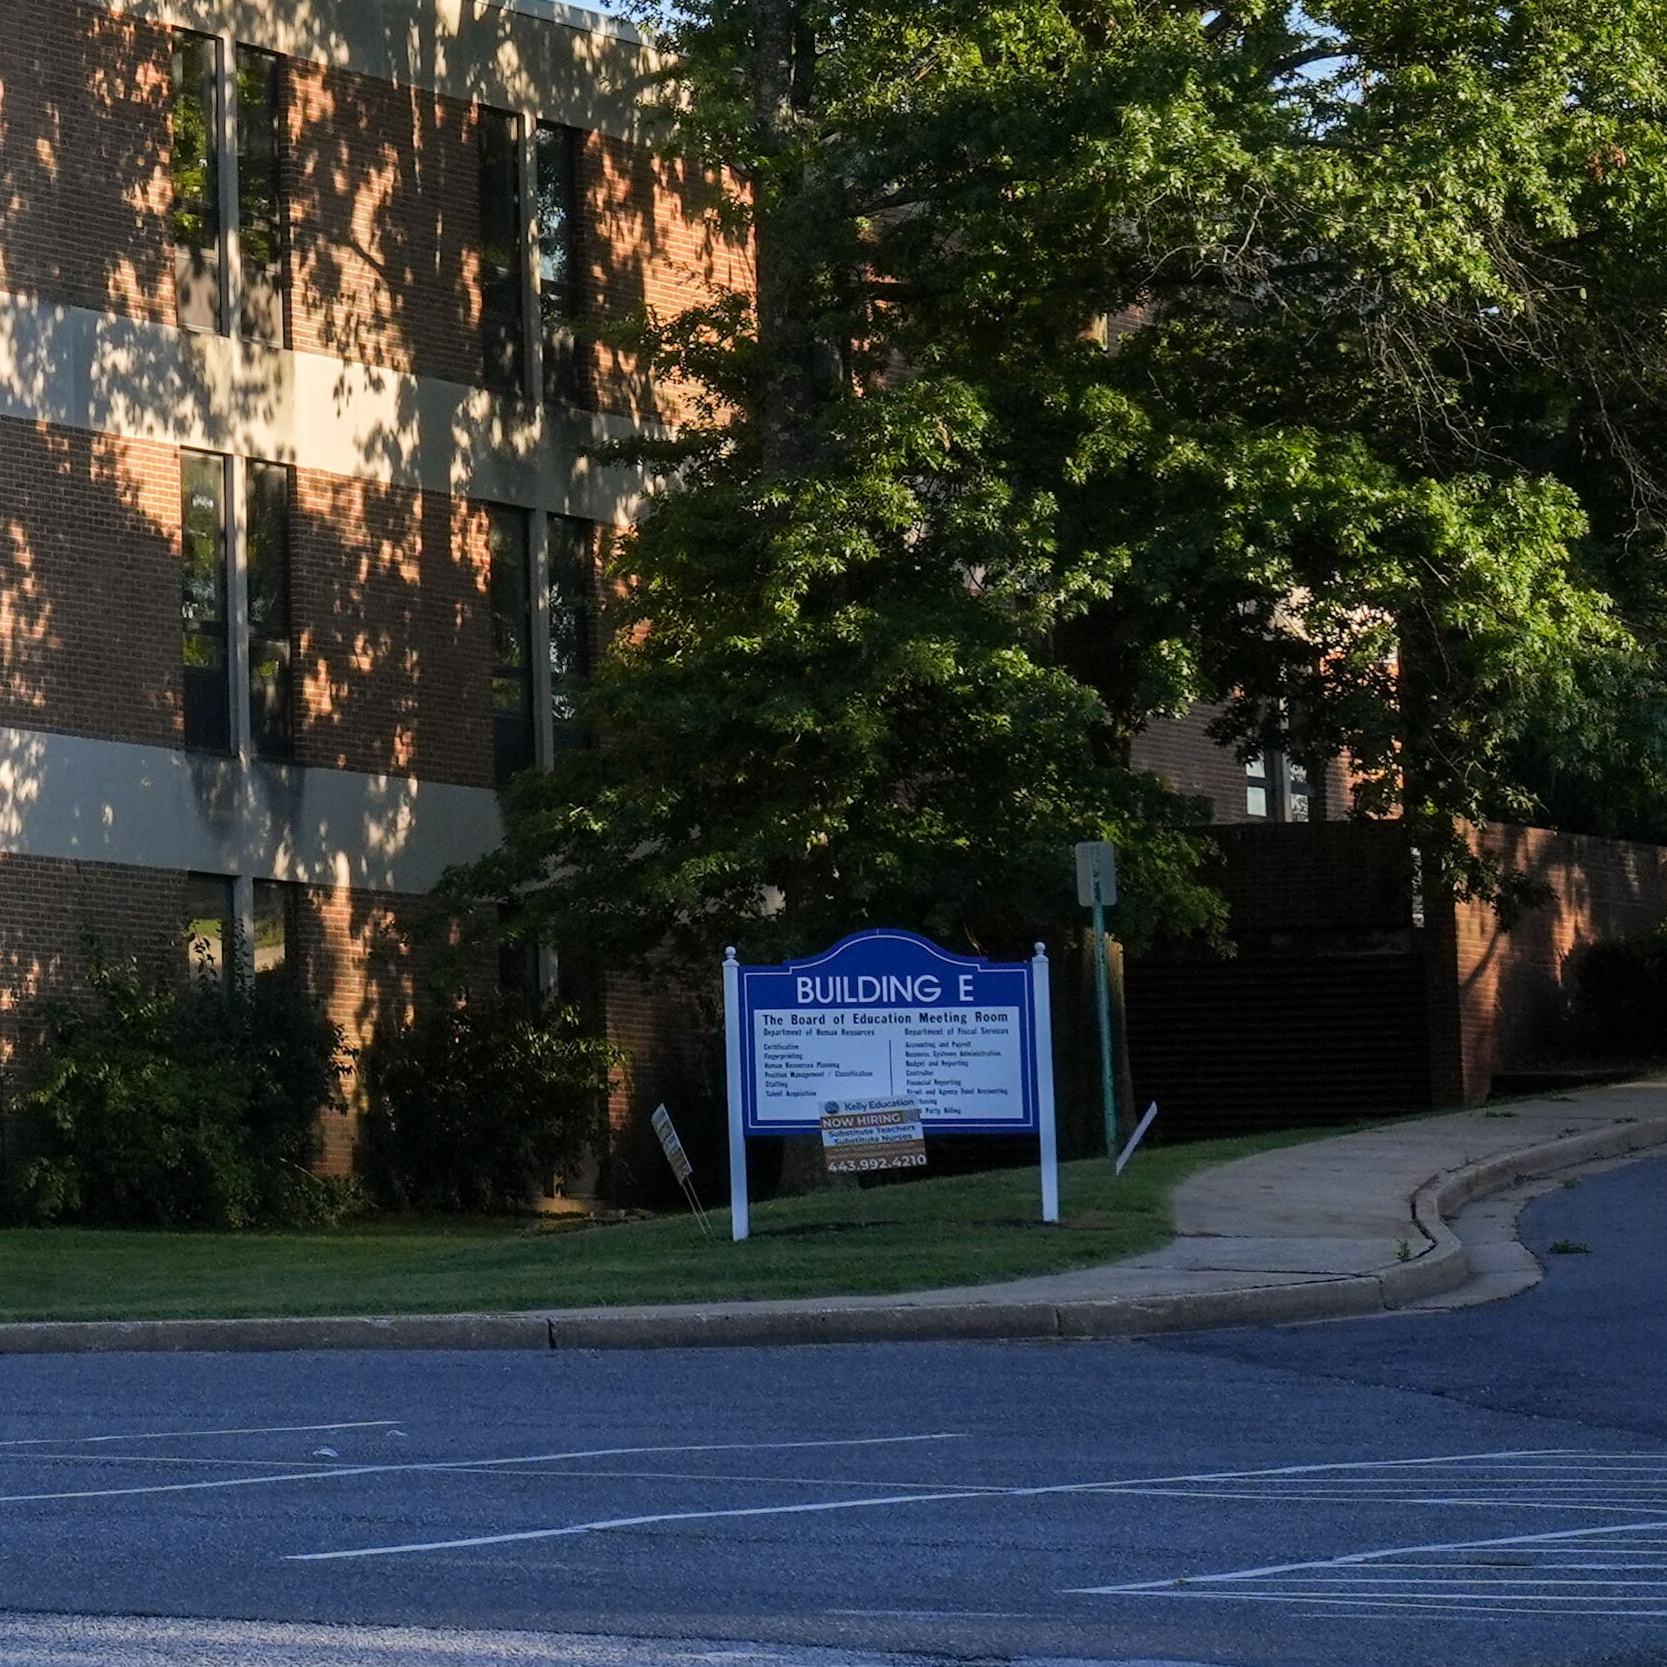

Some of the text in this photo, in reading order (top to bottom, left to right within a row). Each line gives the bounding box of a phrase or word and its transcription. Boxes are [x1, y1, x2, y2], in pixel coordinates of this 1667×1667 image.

[797, 974, 974, 1004] BUILDING E
[762, 1011, 1008, 1026] The Board of Education Meeting Room
[763, 1028, 875, 1037] Department of Human Resources
[904, 1027, 1009, 1036] Department of Fiscal Services
[905, 1041, 936, 1049] Accounting
[764, 1052, 803, 1060] Fingerprinting
[905, 1060, 925, 1068] Budget
[941, 1060, 969, 1068] Reporting
[765, 1080, 788, 1089] Staffing
[934, 1079, 962, 1087] Reporting
[786, 1090, 817, 1098] Acquisition
[844, 1098, 915, 1112] Kelly Education
[822, 1113, 901, 1129] NOW HIRING
[828, 1124, 916, 1138] Substitute Teachers
[834, 1135, 880, 1145] Substitute
[828, 1154, 927, 1173] 443.992.4210
